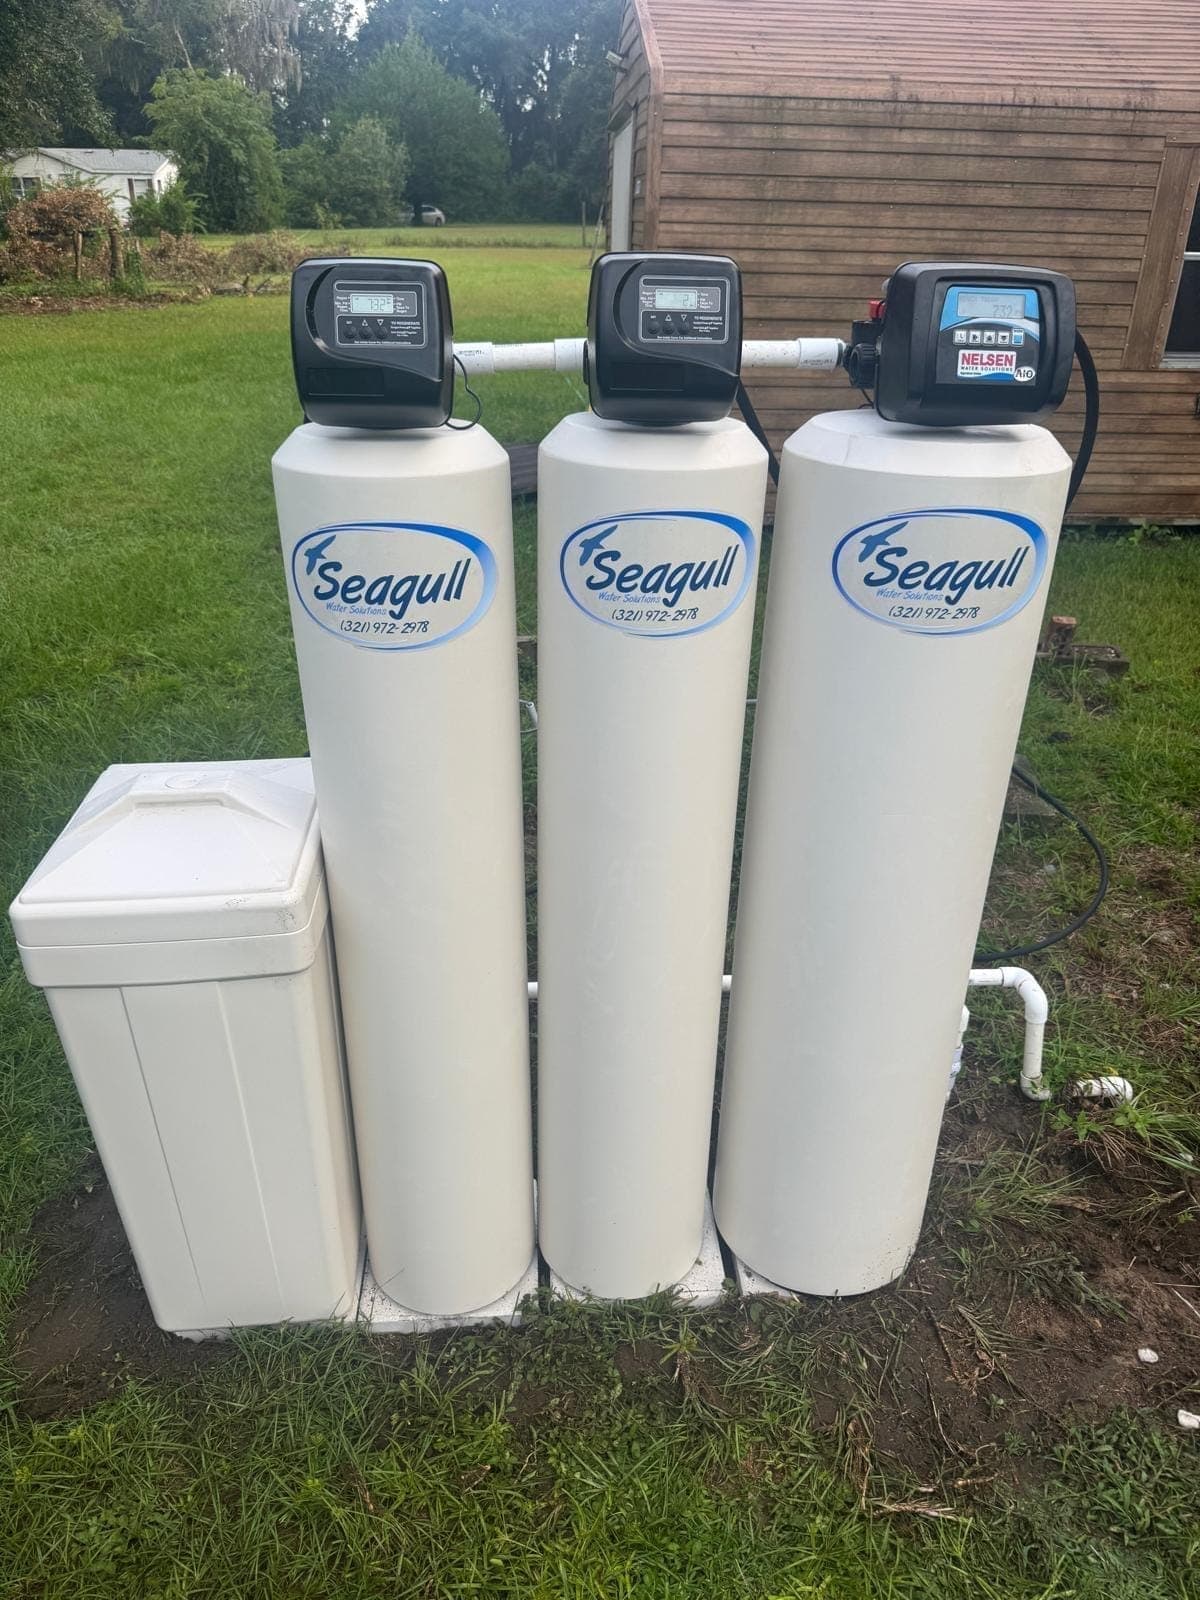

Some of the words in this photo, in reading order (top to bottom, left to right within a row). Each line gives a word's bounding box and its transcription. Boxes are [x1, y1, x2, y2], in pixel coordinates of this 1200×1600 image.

[962, 353, 1013, 366] NELSEN
[586, 544, 739, 607] Seagull
[864, 546, 1030, 605] Seagull
[314, 558, 471, 620] Seagull
[876, 588, 901, 600] Water
[903, 590, 943, 601] Solutions
[598, 591, 621, 602] Water
[623, 593, 660, 604] Solutions
[326, 601, 347, 614] Water
[349, 604, 388, 616] Solutions
